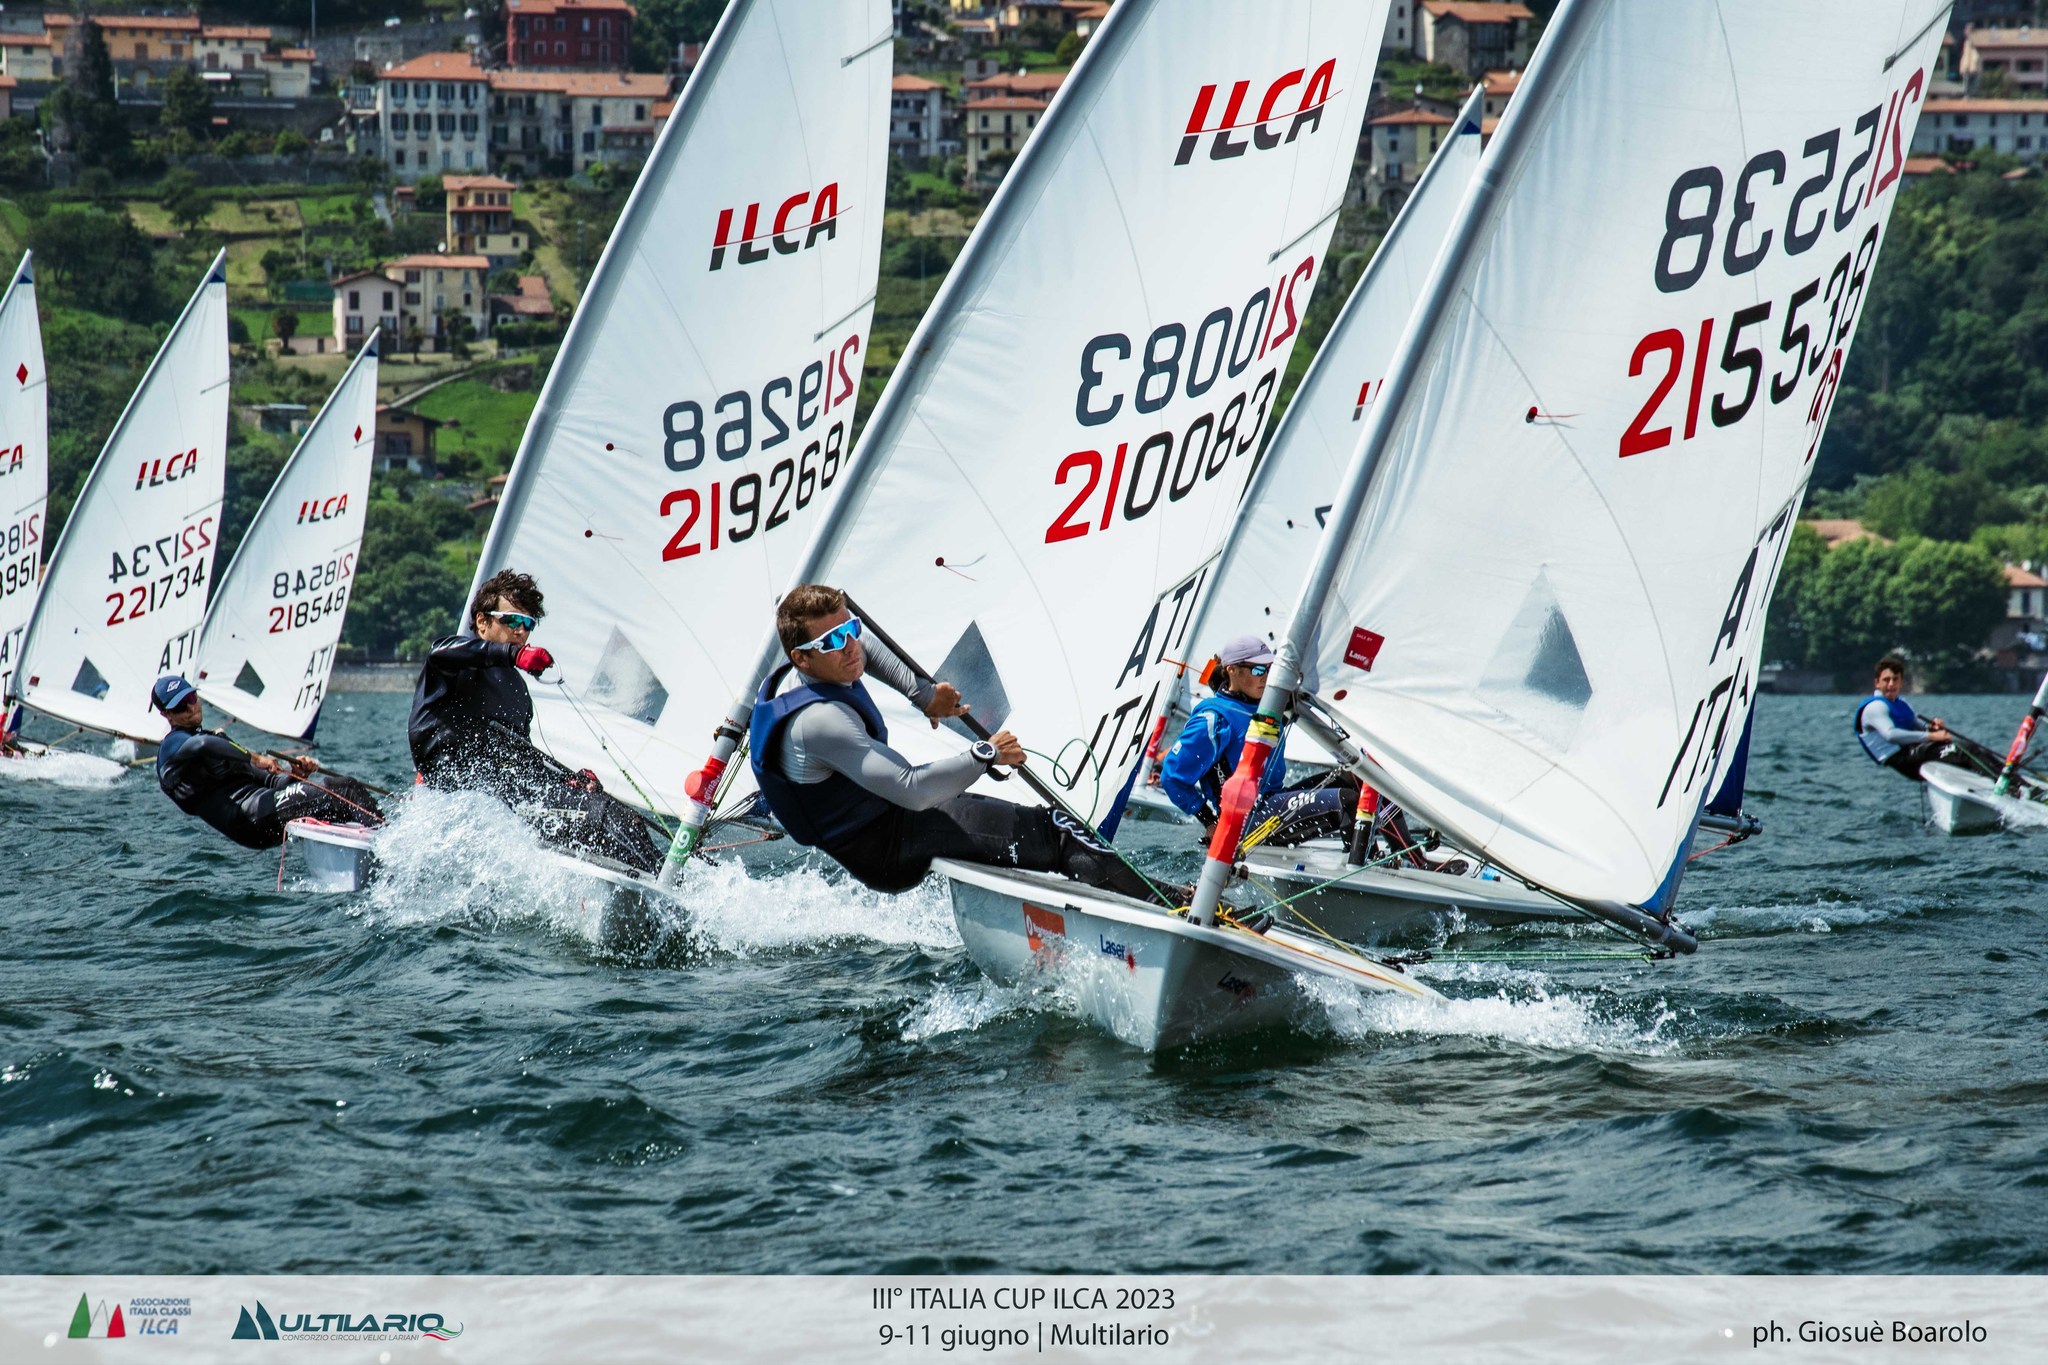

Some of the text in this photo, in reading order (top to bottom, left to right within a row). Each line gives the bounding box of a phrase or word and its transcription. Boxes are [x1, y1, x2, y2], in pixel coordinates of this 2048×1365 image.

[1174, 57, 1338, 166] ILCA
[708, 182, 840, 272] ILCA
[1618, 222, 1879, 459] 215538
[135, 448, 198, 491] ILCA
[1044, 368, 1277, 544] 210083
[297, 494, 348, 525] ILCA
[660, 421, 843, 562] 219268
[0, 551, 36, 600] 951
[105, 557, 205, 627] 221734
[269, 586, 346, 634] 218548
[1349, 650, 1368, 662] Laser
[294, 679, 323, 711] ITA
[1066, 680, 1160, 791] ITA
[1100, 934, 1125, 960] Laser
